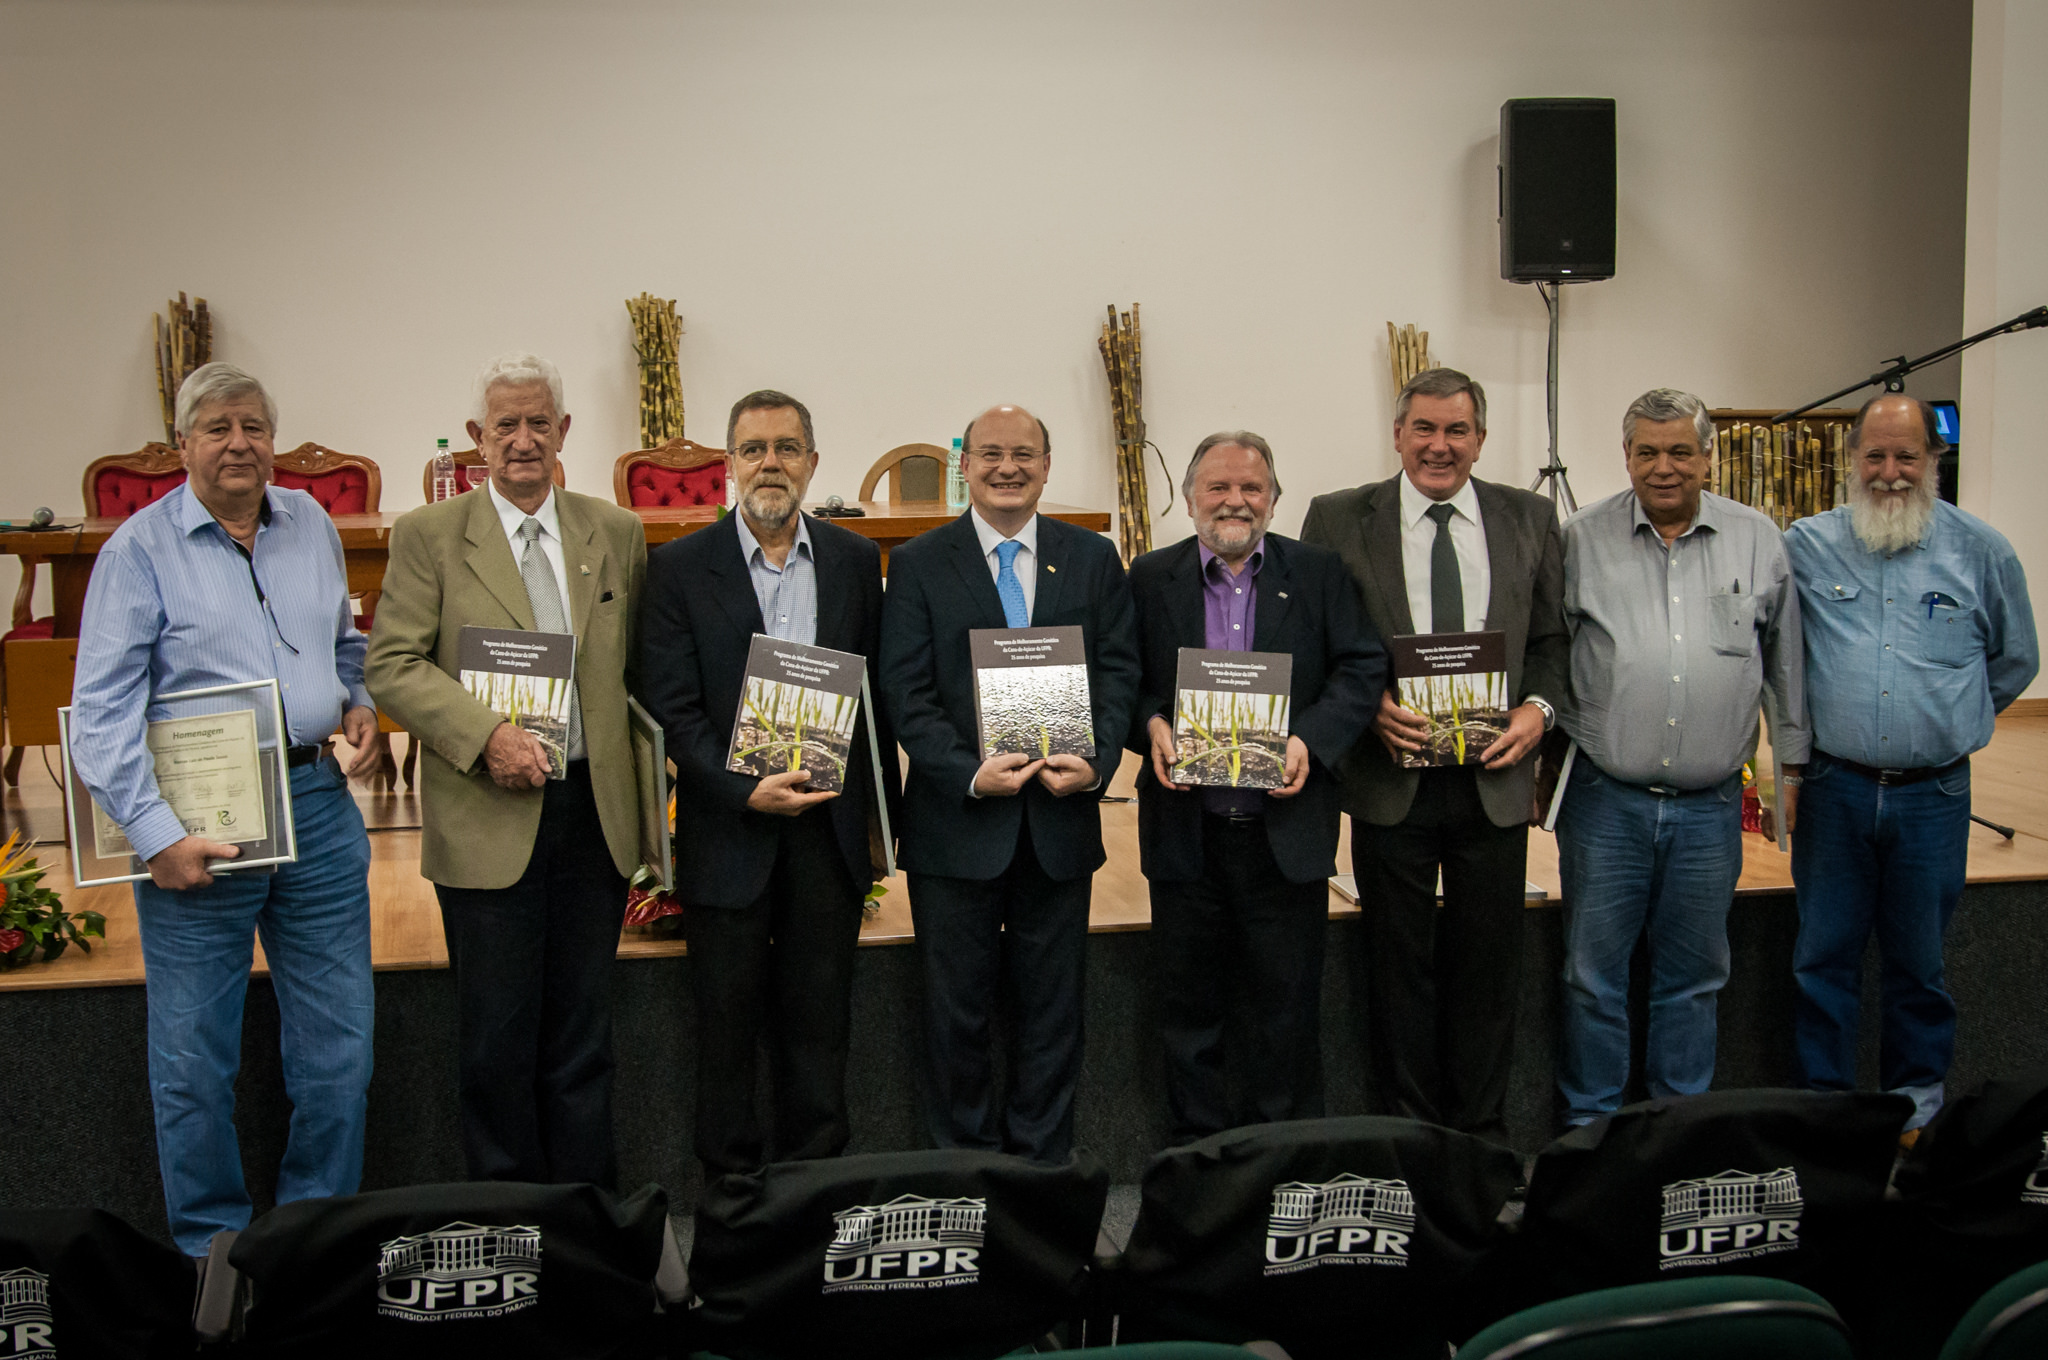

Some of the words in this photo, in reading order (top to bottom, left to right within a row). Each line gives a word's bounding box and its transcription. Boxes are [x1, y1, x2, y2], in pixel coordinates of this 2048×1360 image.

[173, 728, 224, 740] Homenagem
[1266, 1228, 1410, 1263] UFPR
[1660, 1220, 1799, 1256] UFPR
[824, 1248, 979, 1283] UFPR
[1264, 1260, 1319, 1276] UNIVERSIDADE
[1660, 1258, 1718, 1270] UNIVERSIDADE
[1719, 1253, 1751, 1263] FEDERAL
[1754, 1248, 1766, 1257] DO
[378, 1272, 538, 1309] UFPR
[822, 1284, 885, 1294] UNIVERSIDADE
[945, 1276, 978, 1286] PARANÁ
[378, 1308, 441, 1321] UNIVERSIDADE
[445, 1312, 484, 1320] FEDERAL
[505, 1299, 537, 1314] PARANÁ
